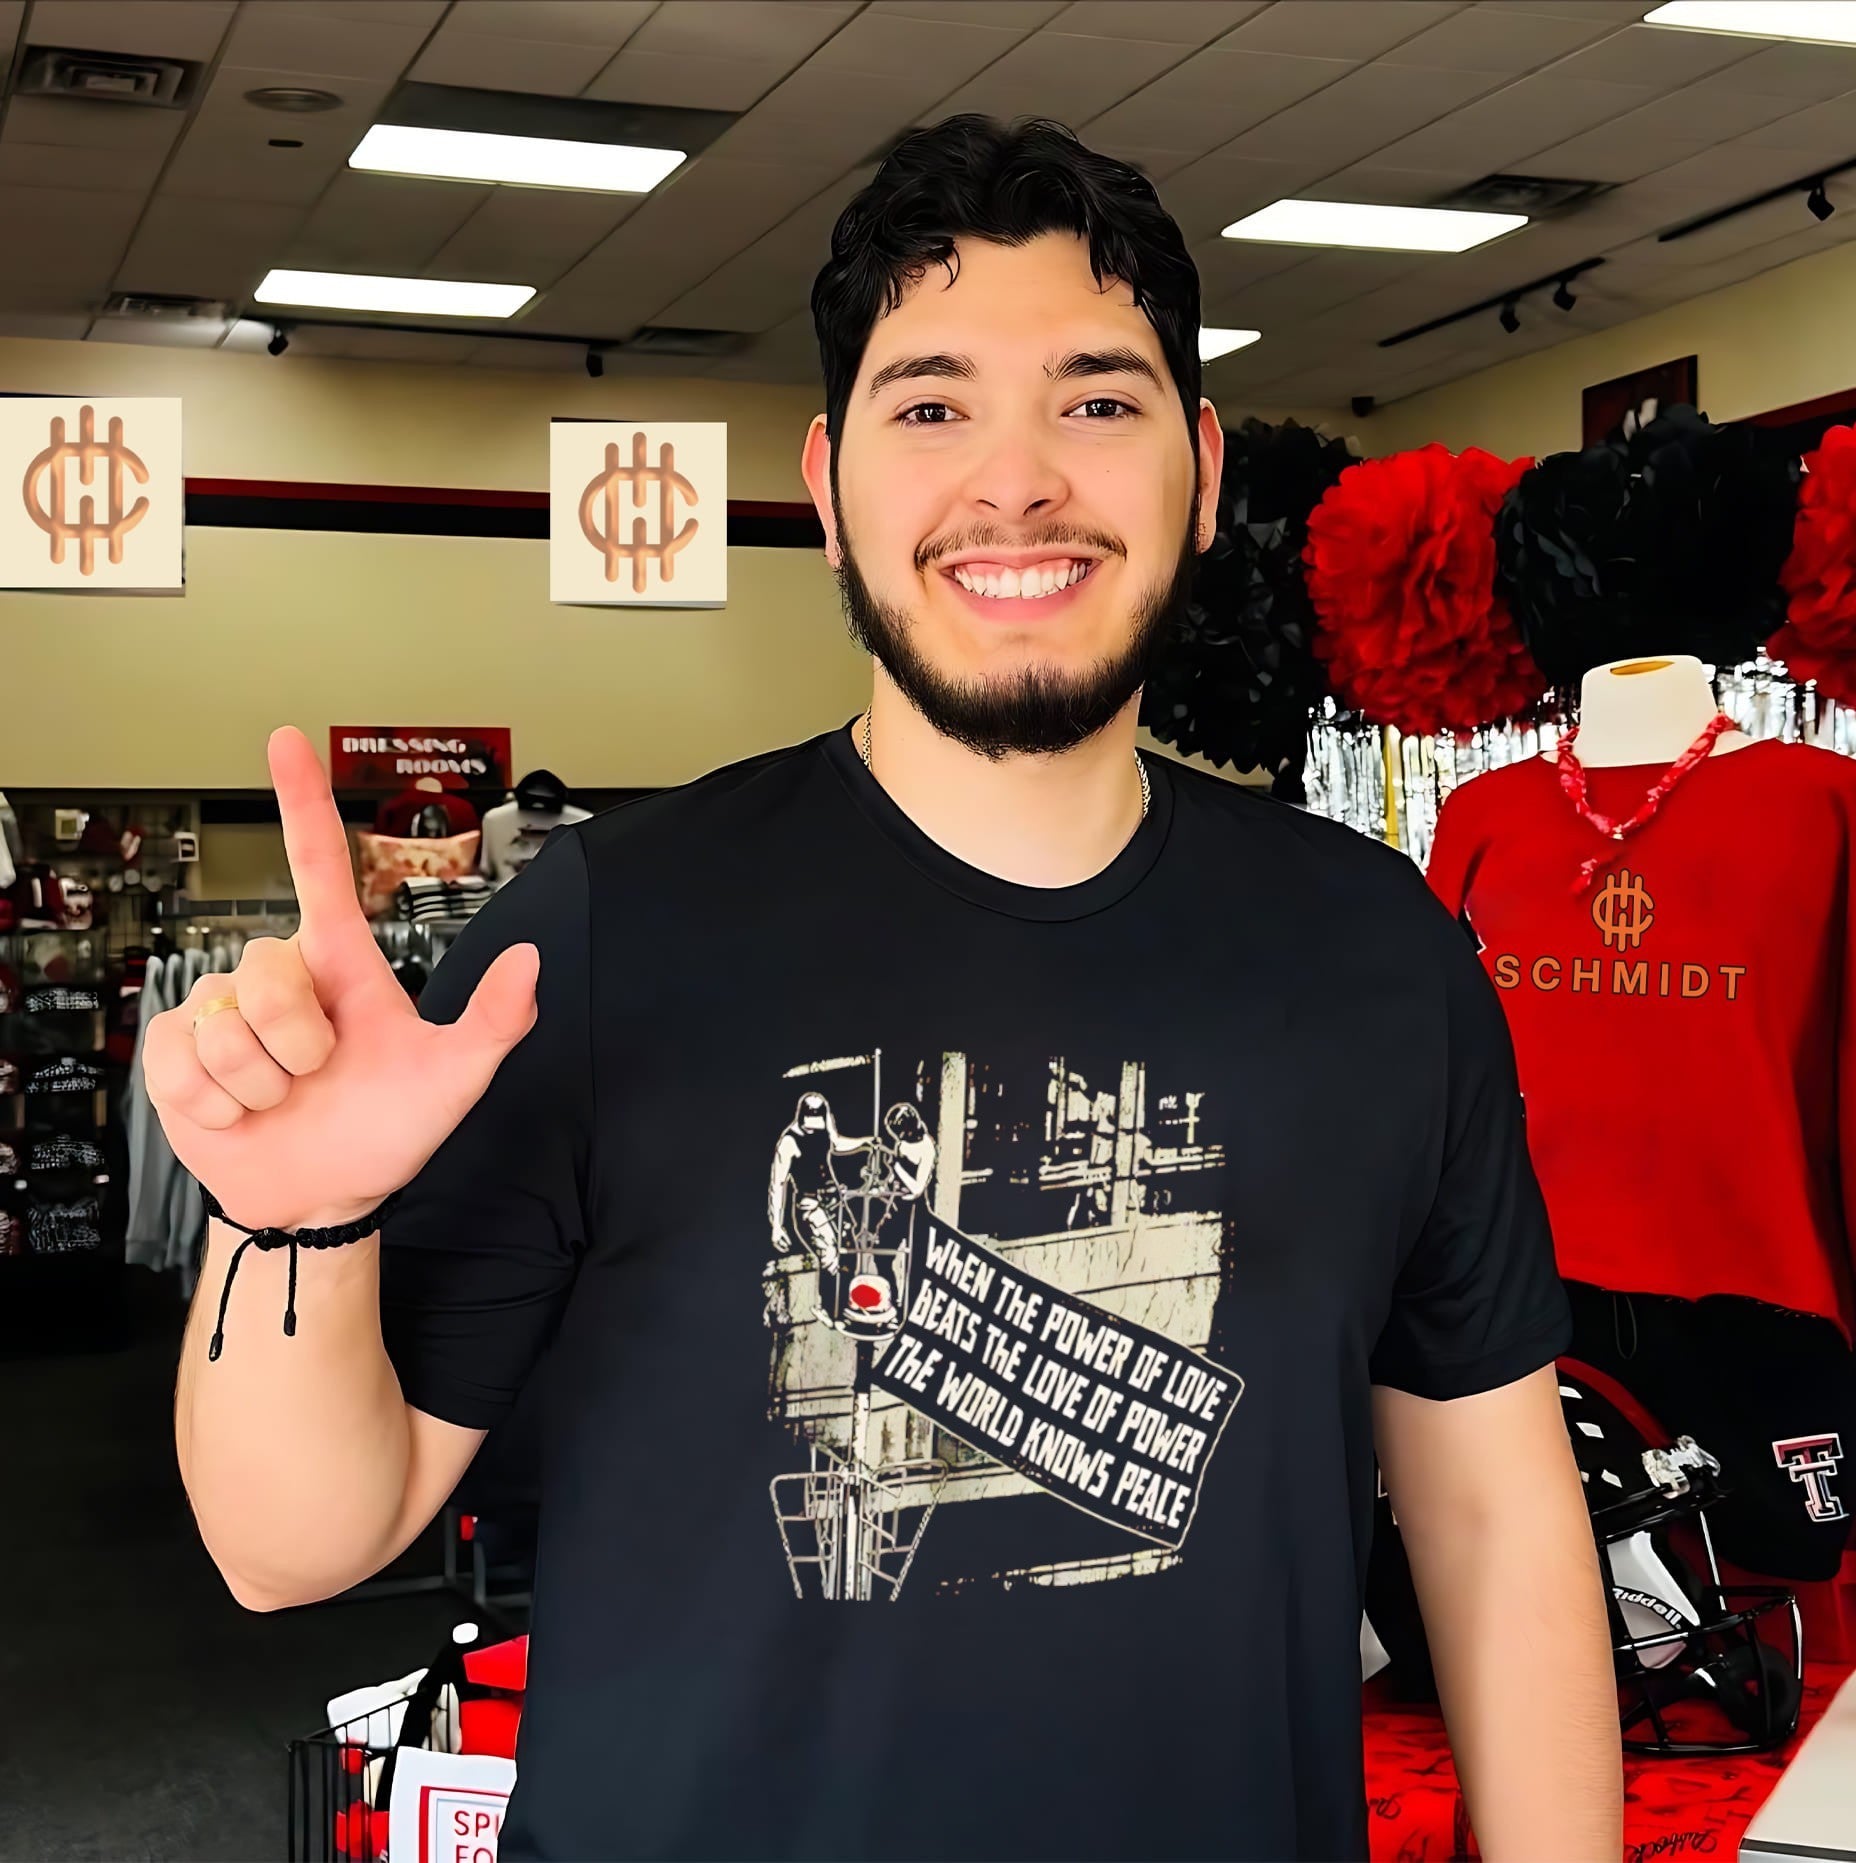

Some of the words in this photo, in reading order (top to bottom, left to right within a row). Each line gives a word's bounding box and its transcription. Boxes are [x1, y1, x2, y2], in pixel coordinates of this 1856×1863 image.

[396, 758, 487, 774] ROOMS
[1494, 954, 1746, 1000] SCHMIDT
[1021, 1354, 1091, 1420] LOVE
[1081, 1383, 1125, 1434] OF
[1116, 1399, 1207, 1475] POWER
[1039, 1303, 1135, 1380] POWER
[1127, 1344, 1170, 1393] OF
[1161, 1360, 1228, 1422] LOVE
[936, 1361, 1024, 1447] WORLD
[1019, 1417, 1116, 1498] KNOWS
[1111, 1460, 1192, 1529] PEACE
